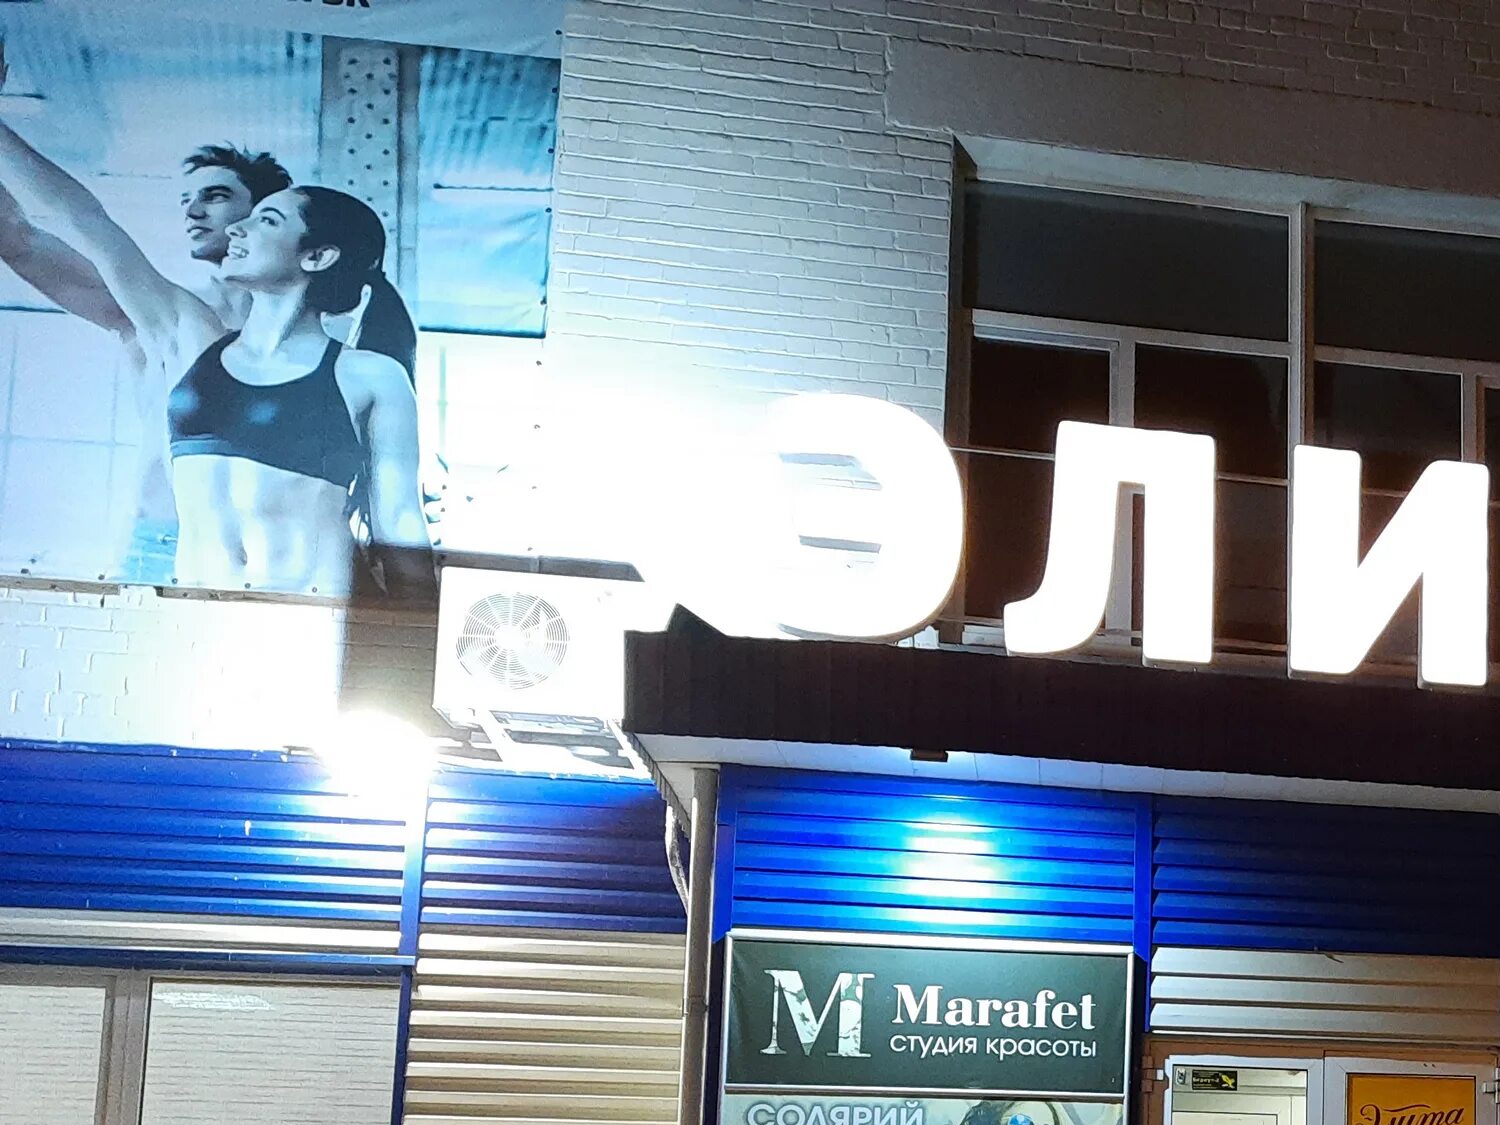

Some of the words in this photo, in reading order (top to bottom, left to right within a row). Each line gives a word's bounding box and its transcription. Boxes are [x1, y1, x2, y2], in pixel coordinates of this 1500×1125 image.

[891, 984, 1097, 1030] Marafet
[889, 1034, 978, 1059] студия
[986, 1037, 1097, 1061] красоты
